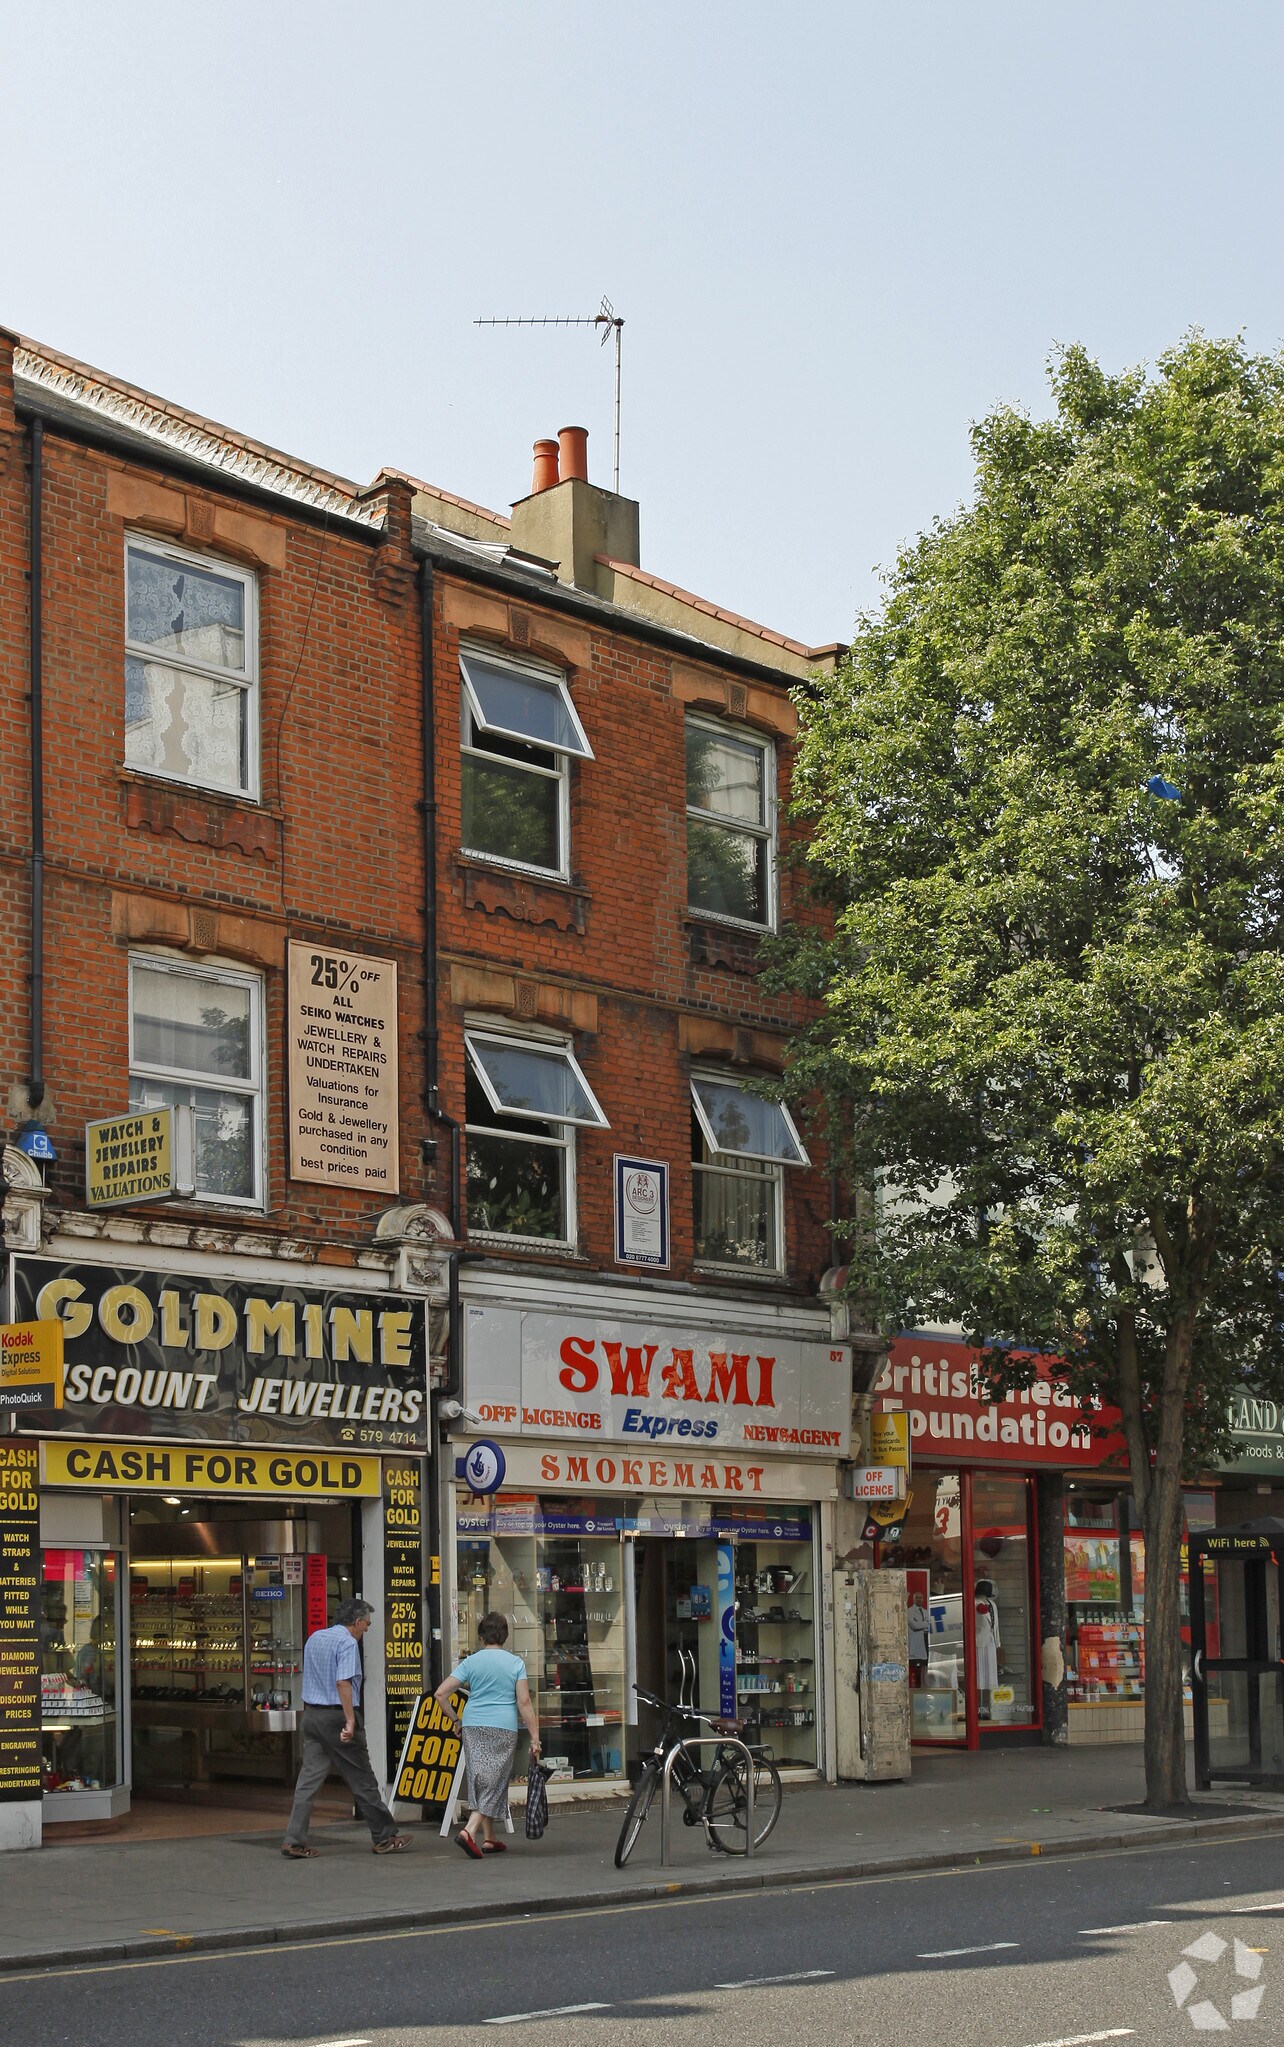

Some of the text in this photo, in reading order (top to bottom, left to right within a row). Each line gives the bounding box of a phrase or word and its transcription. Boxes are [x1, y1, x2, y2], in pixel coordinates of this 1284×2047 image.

[310, 955, 381, 993] 25% OFF
[333, 995, 353, 1008] ALL
[300, 1005, 385, 1030] SEIKO WATCHES
[304, 1024, 381, 1048] JEWELLERY &
[298, 1038, 387, 1064] WATCH REPAIRS
[306, 1056, 380, 1078] UNDERTAKEN
[306, 1076, 378, 1097] Valuations for
[318, 1092, 368, 1110] Insurance
[298, 1108, 388, 1134] Gold & Jewellery
[99, 1117, 160, 1144] WATCH &
[299, 1124, 388, 1148] purchased in any
[28, 1150, 52, 1160] Chubb
[96, 1135, 164, 1163] JEWELLERY
[320, 1142, 368, 1158] condition
[103, 1156, 158, 1180] REPAIRS
[300, 1156, 387, 1180] best prices paid
[91, 1173, 170, 1201] VALUATIONS
[632, 1188, 654, 1198] ARC 3
[1, 1331, 34, 1348] Kodak
[1, 1350, 40, 1367] Express
[1, 1366, 40, 1378] Digital Solutions
[559, 1336, 776, 1408] SWAMI
[0, 1392, 42, 1405] PhotoQuick
[238, 1378, 422, 1423] JEWELLERS
[479, 1404, 602, 1430] OFF LICENCE
[622, 1408, 718, 1438] Express
[360, 1430, 416, 1444] 579 4714
[743, 1424, 842, 1447] NEWSAGENT
[873, 1438, 900, 1446] Travelcards
[0, 1449, 38, 1468] CASH
[1276, 1445, 1284, 1459] &
[66, 1449, 362, 1488] CASH FOR GOLD
[540, 1454, 764, 1492] SMOKEMART
[866, 1472, 882, 1482] OFF
[2, 1470, 32, 1489] FOR
[386, 1470, 419, 1487] CASH
[390, 1490, 414, 1506] FOR
[856, 1485, 894, 1496] LICENCE
[0, 1492, 38, 1510] GOLD
[386, 1508, 420, 1526] GOLD
[459, 1517, 490, 1528] oyster
[496, 1520, 506, 1528] Buy
[534, 1522, 546, 1530] your
[548, 1522, 566, 1530] Oyster
[664, 1522, 690, 1534] oyster
[4, 1534, 30, 1542] WATCH
[386, 1540, 420, 1549] JEWELLERY
[1208, 1538, 1256, 1548] WiFi here
[2, 1548, 30, 1556] STRAPS
[14, 1562, 20, 1570] &
[393, 1566, 414, 1574] WATCH
[392, 1579, 416, 1588] REPAIRS
[4, 1592, 30, 1600] FITTED
[6, 1606, 29, 1614] WHILE
[392, 1602, 416, 1620] 25%
[0, 1620, 34, 1629] YOU WAIT
[392, 1622, 416, 1639] OFF
[1, 1652, 34, 1660] DIAMOND
[386, 1642, 422, 1659] SEIKO
[14, 1681, 23, 1690] AT
[388, 1674, 421, 1682] INSURANCE
[0, 1695, 37, 1704] DISCOUNT
[386, 1686, 422, 1696] VALUATIONS
[6, 1710, 32, 1719] PRICES
[1, 1742, 36, 1750] ENGRAVING
[406, 1734, 460, 1768] FOR
[0, 1779, 40, 1788] UNDERTAKEN
[398, 1767, 452, 1802] GOLD
